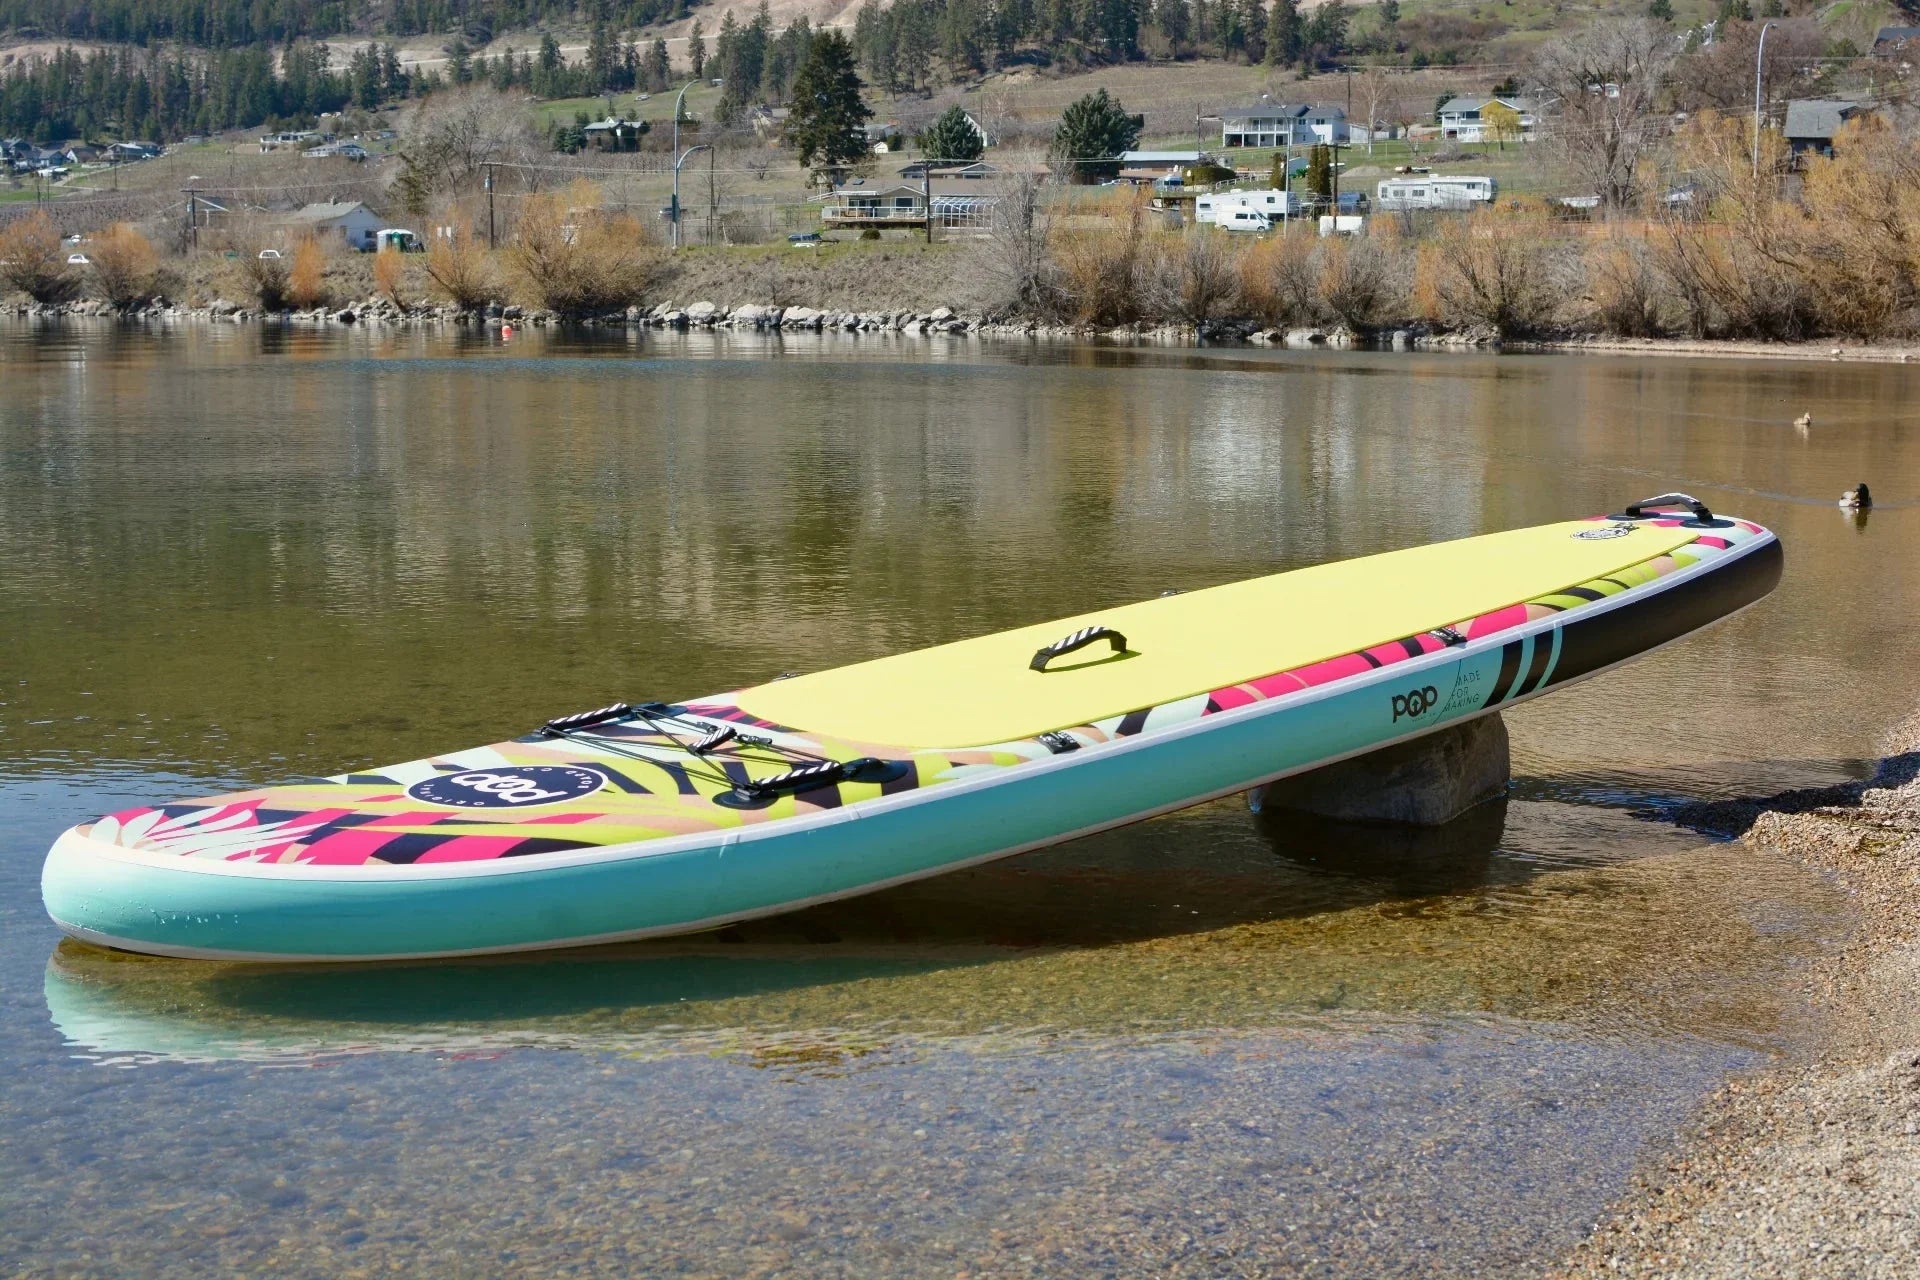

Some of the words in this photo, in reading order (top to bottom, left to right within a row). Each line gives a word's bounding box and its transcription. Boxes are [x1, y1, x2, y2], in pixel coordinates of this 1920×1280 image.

[1457, 671, 1481, 686] MADE
[1452, 687, 1469, 699] FOR
[565, 770, 593, 789] BOARD
[420, 783, 485, 806] ORIGINAL
